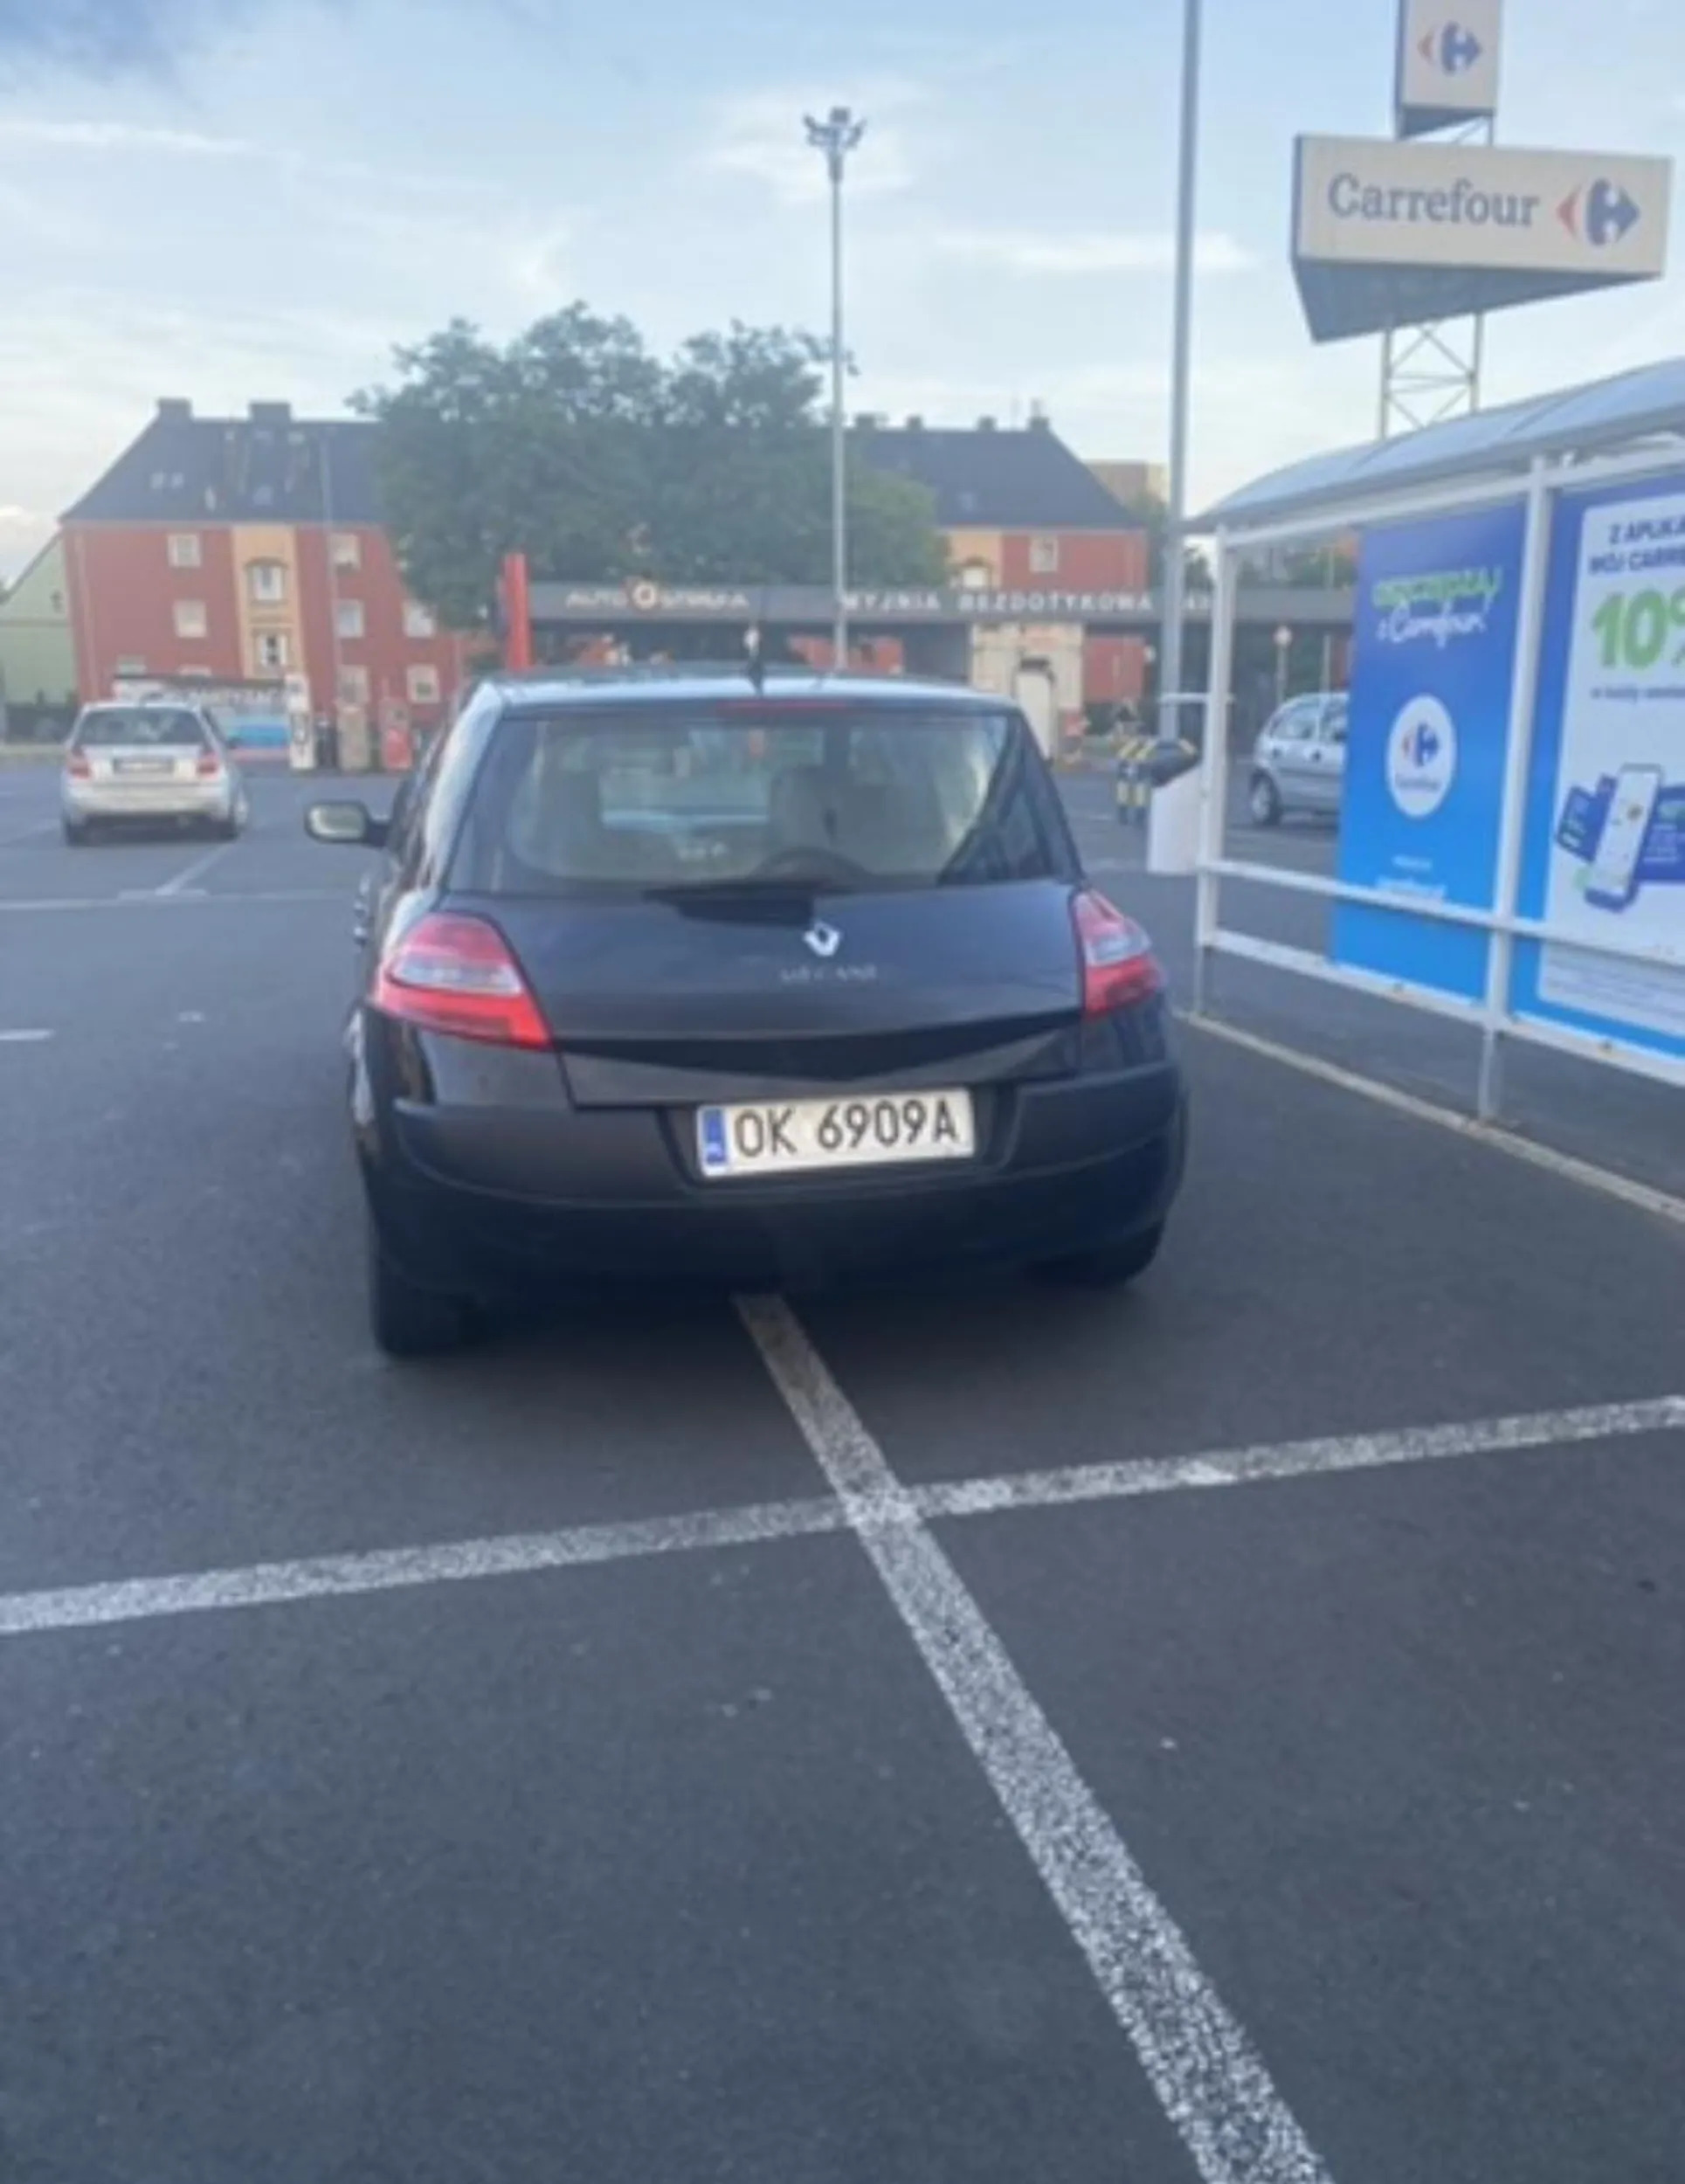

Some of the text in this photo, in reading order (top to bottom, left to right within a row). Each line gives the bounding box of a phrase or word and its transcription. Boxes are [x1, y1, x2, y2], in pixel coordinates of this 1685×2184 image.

[1328, 173, 1540, 226] Carrefour
[734, 1097, 959, 1158] OK 6909A
